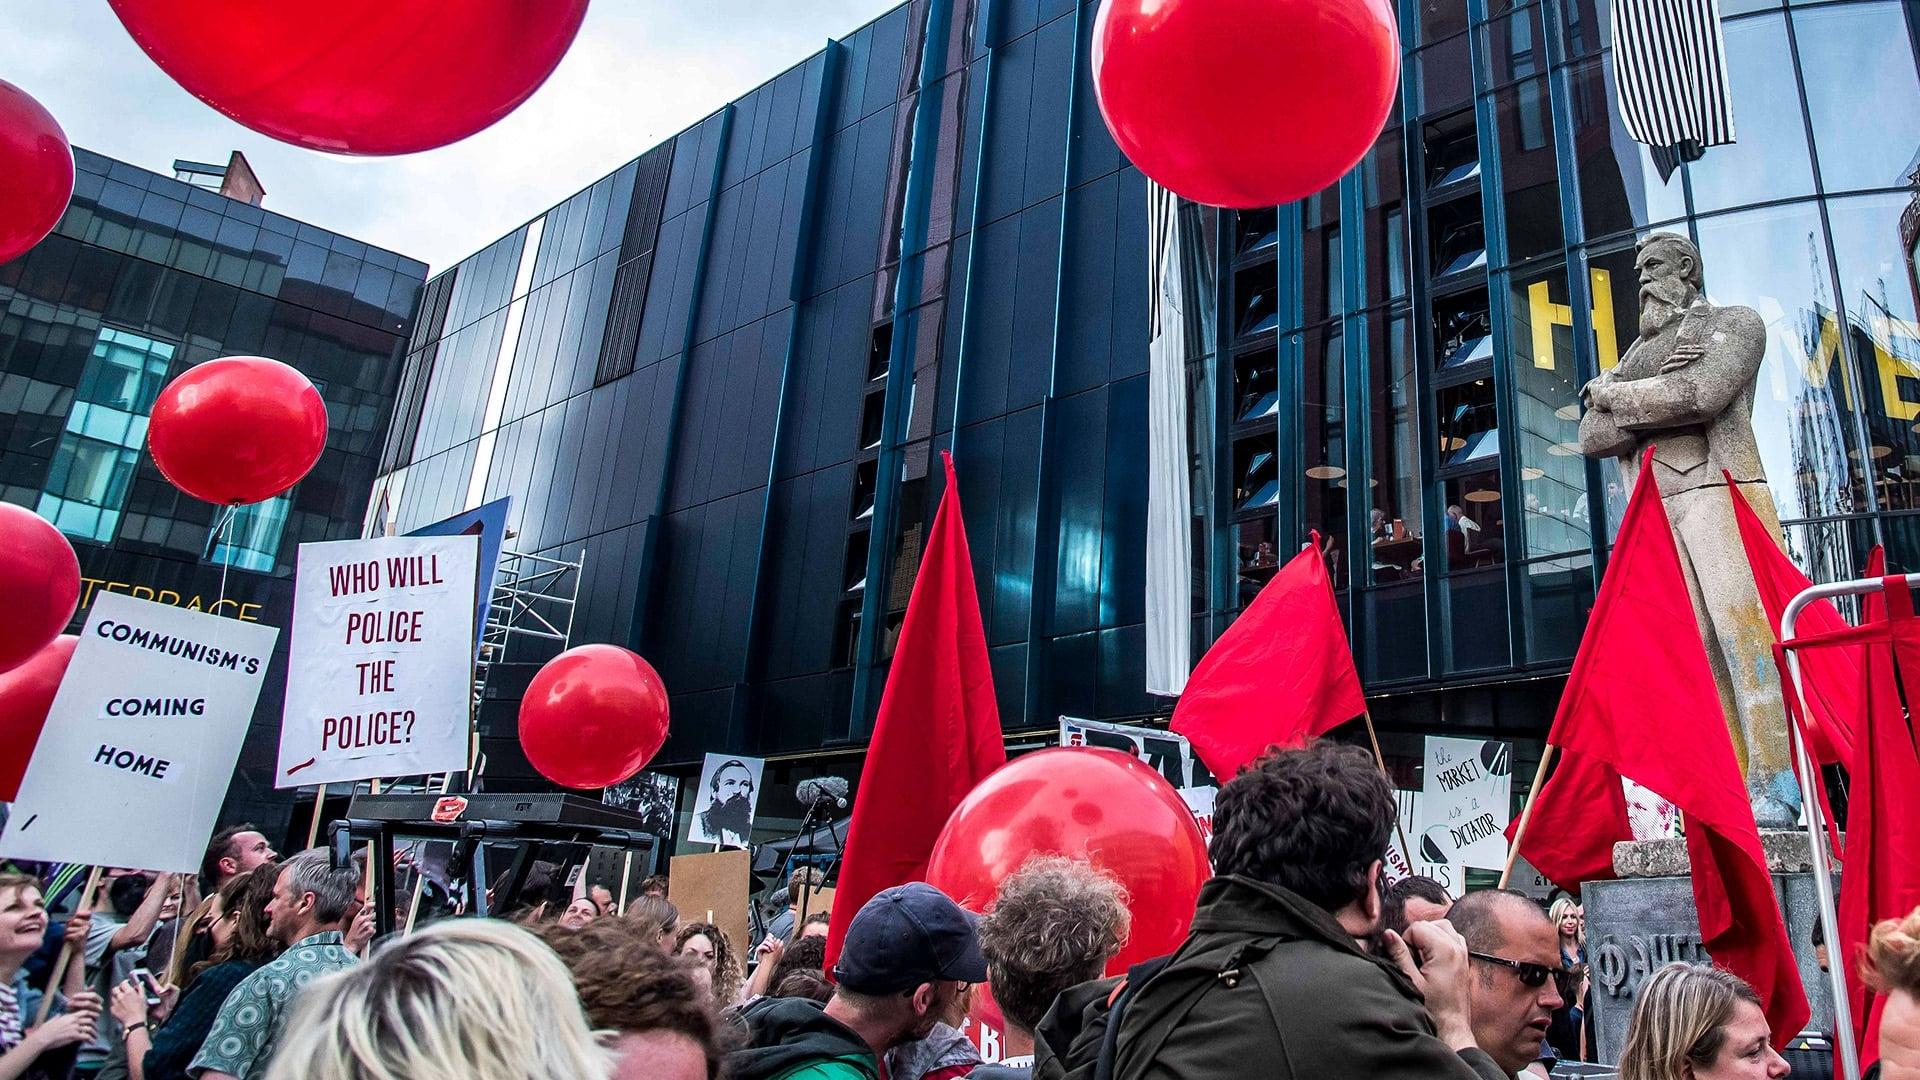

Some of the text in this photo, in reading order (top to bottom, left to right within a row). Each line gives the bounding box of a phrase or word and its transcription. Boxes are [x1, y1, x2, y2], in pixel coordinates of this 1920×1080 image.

[329, 554, 444, 597] WHO WILL
[345, 610, 424, 645] POLICE
[97, 619, 260, 675] COMMUNISM'S
[355, 659, 396, 696] THE
[106, 698, 205, 717] COMING
[322, 710, 416, 752] POLICE?
[94, 744, 171, 779] HOME
[1435, 747, 1453, 767] the
[1435, 758, 1481, 793] MARKET
[1471, 798, 1480, 811] a
[1449, 812, 1502, 849] DICTATOR
